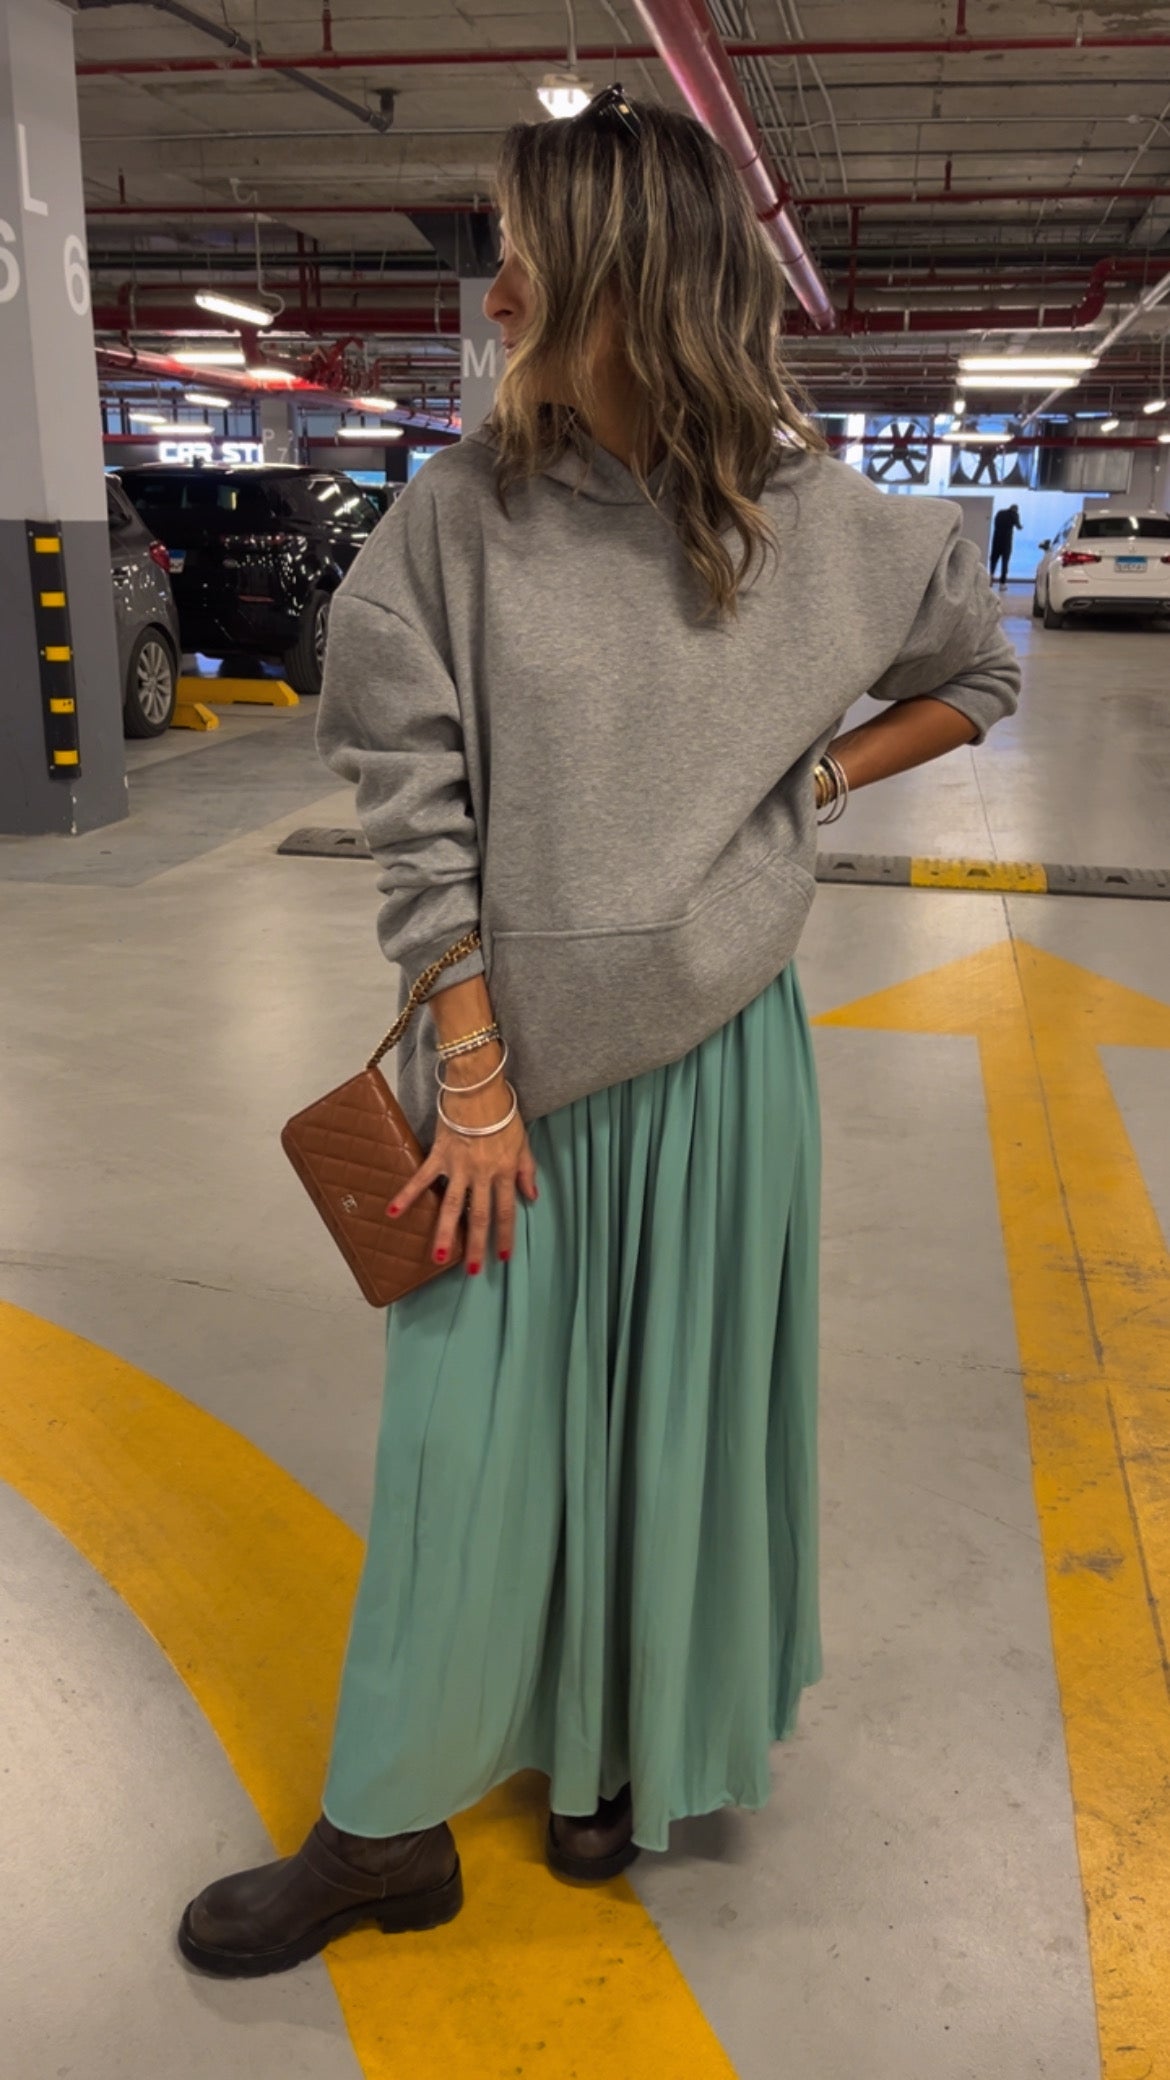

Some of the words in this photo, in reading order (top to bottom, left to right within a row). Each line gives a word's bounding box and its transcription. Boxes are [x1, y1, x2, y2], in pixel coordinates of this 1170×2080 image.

[18, 123, 48, 216] L
[63, 234, 91, 316] 6
[462, 338, 496, 378] M
